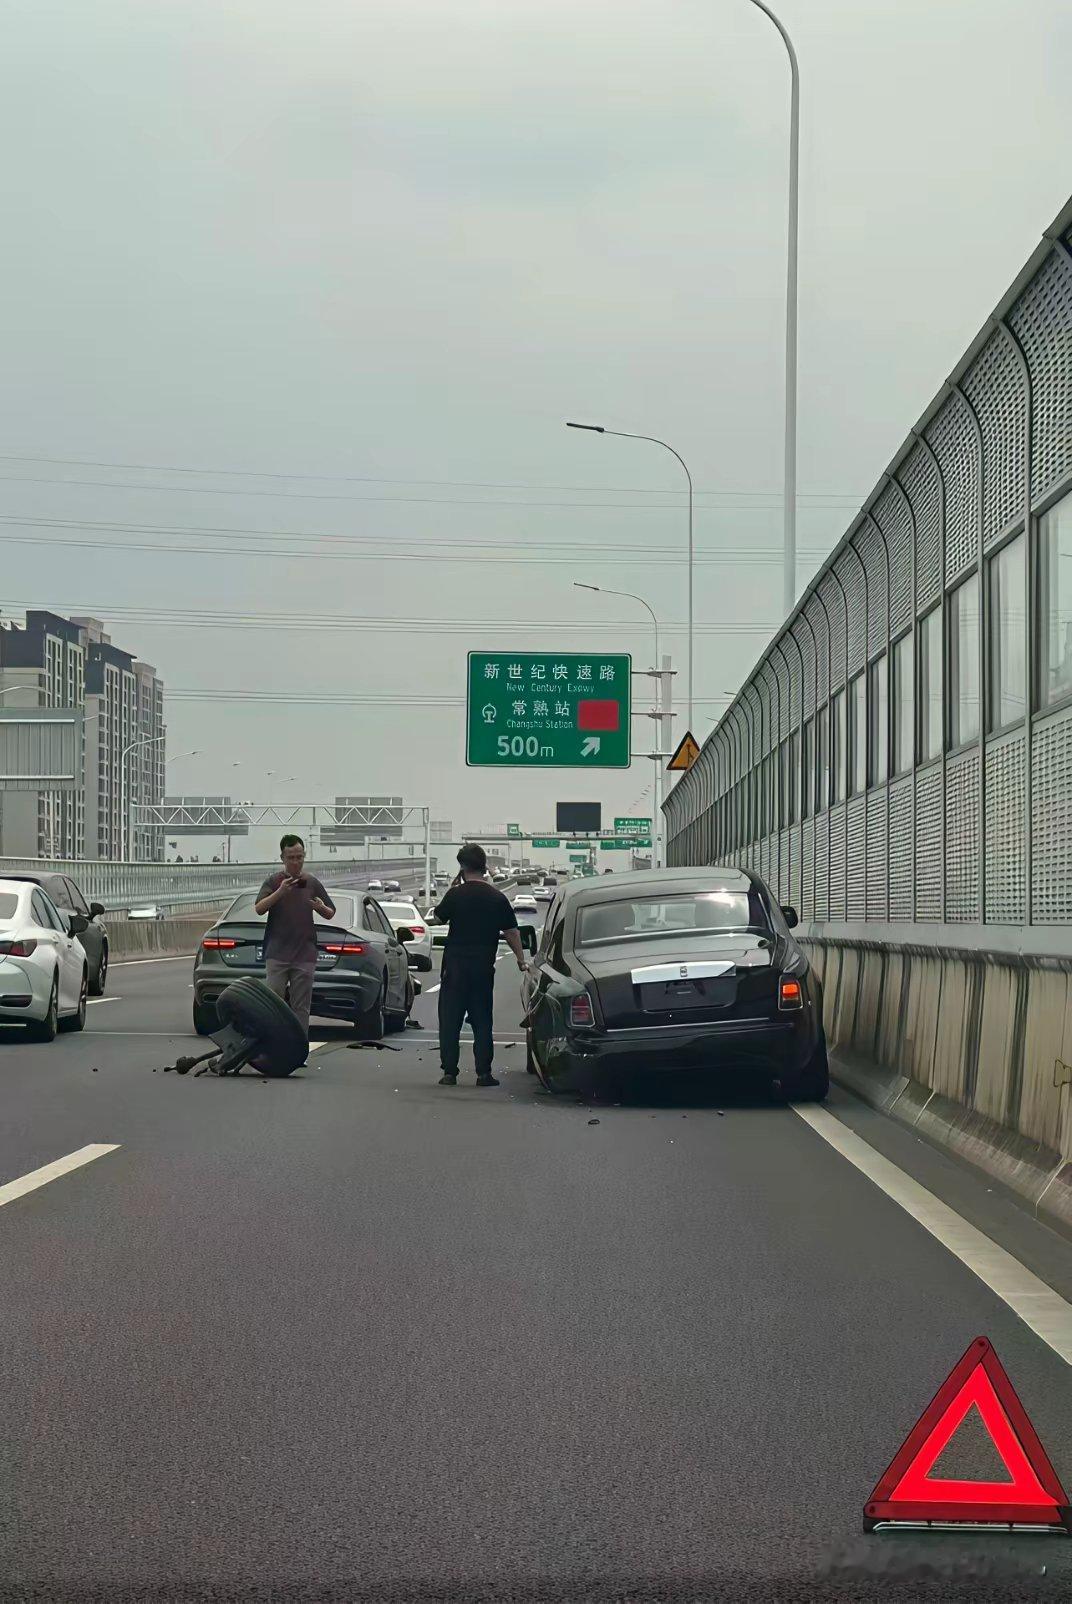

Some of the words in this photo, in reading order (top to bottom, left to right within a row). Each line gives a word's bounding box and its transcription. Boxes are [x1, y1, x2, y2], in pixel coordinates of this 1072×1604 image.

[484, 663, 616, 681] 新世纪快速路
[506, 683, 525, 692] New
[531, 683, 562, 693] Century
[511, 700, 571, 717] 常熟站
[506, 719, 543, 730] Changshu
[545, 719, 573, 729] Station
